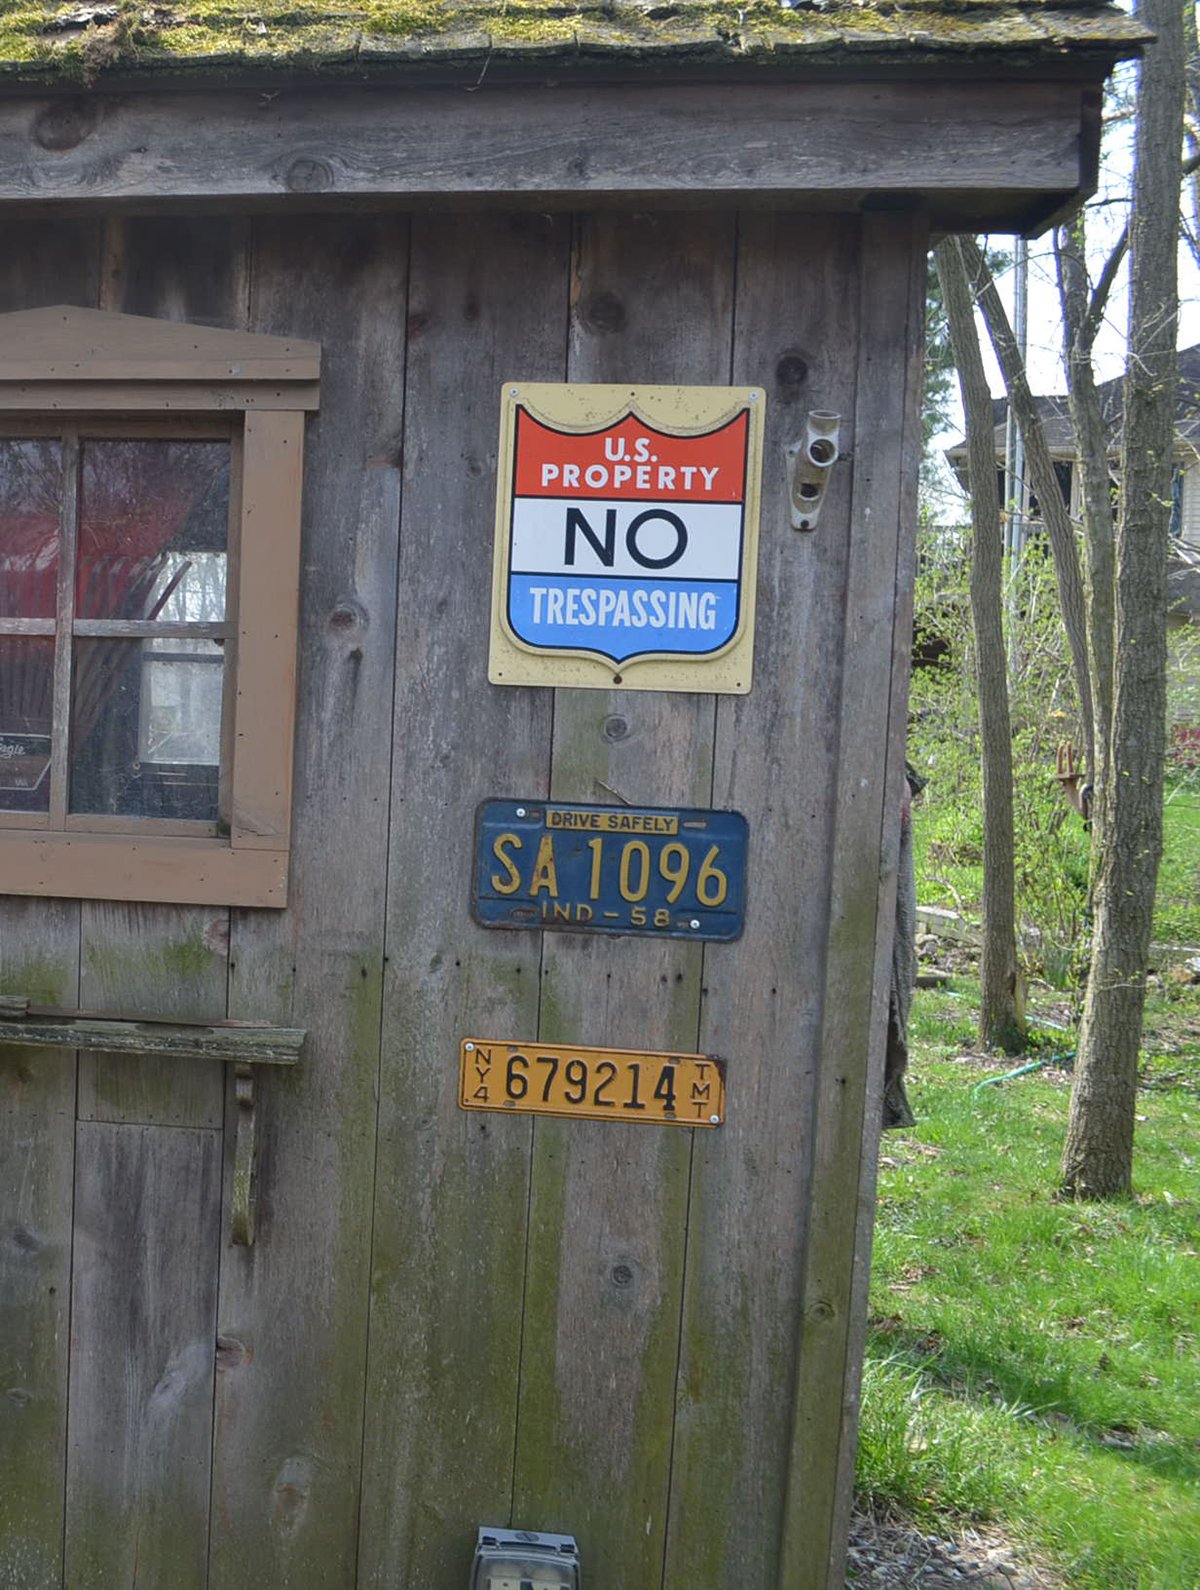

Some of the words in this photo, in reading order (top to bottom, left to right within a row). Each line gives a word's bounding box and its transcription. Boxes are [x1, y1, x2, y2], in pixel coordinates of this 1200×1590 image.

[604, 437, 658, 462] U.S.
[541, 463, 720, 491] PROPERTY
[564, 507, 688, 569] NO
[529, 587, 718, 630] TRESPASSING
[551, 812, 601, 828] DRIVE
[608, 815, 674, 832] SAFELY
[506, 1055, 677, 1111] 679214
